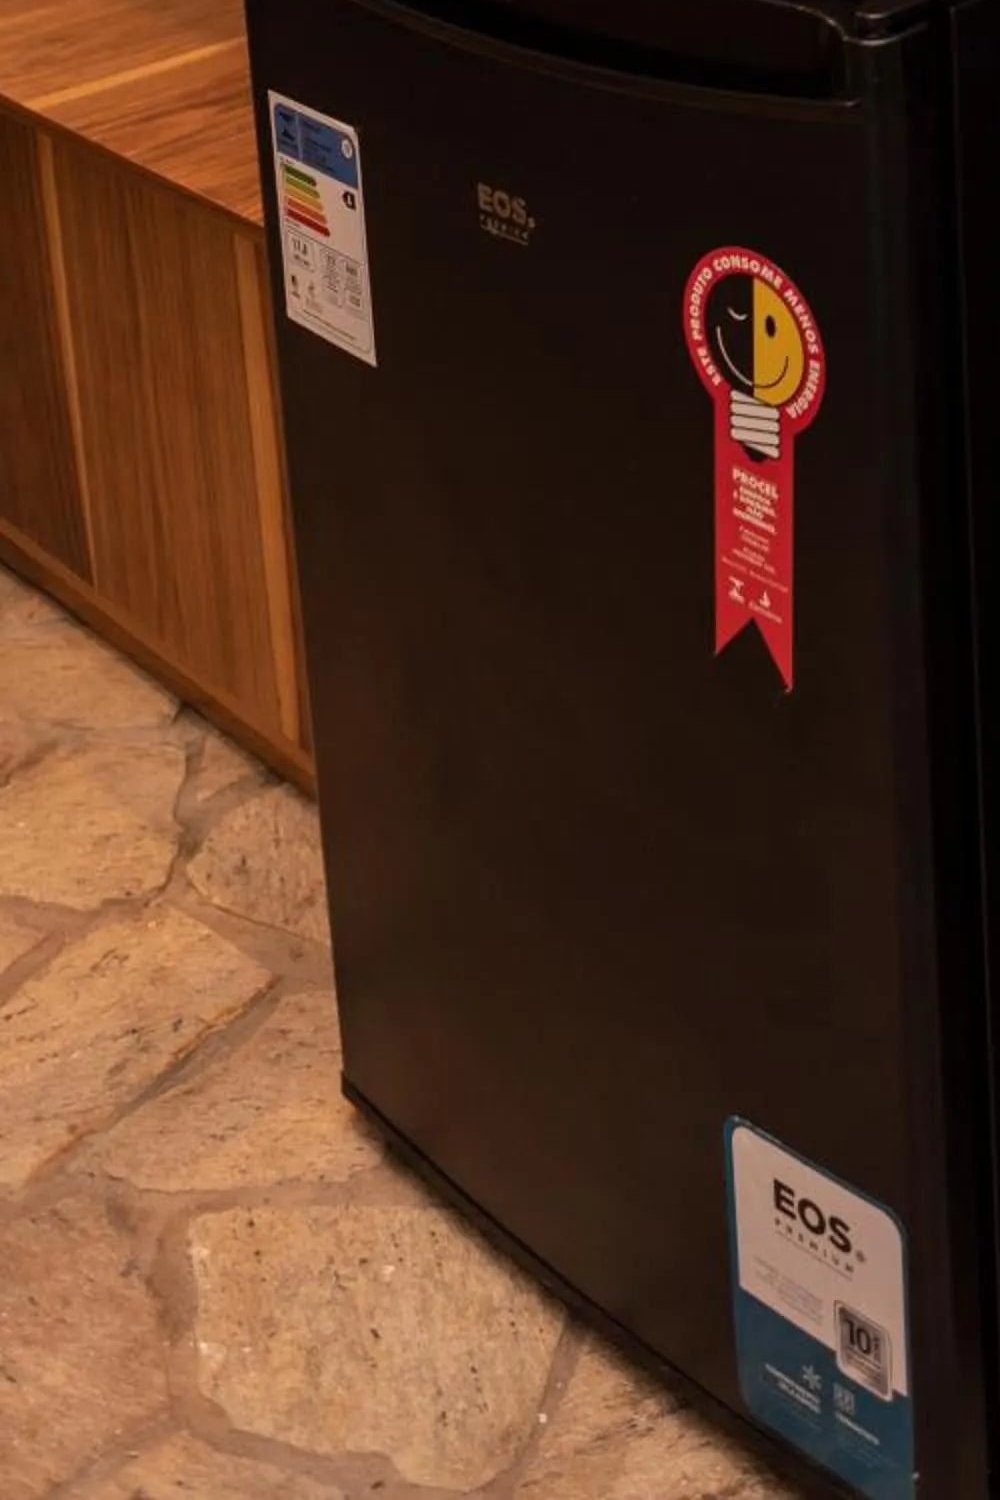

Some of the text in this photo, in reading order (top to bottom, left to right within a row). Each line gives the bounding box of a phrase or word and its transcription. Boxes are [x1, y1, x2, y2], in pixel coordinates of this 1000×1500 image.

[478, 182, 527, 226] EOS
[688, 255, 821, 420] ESTE PRODUTO CONSOME MENOS ENERGIA
[773, 1178, 853, 1253] EOS
[844, 1315, 872, 1355] 10
